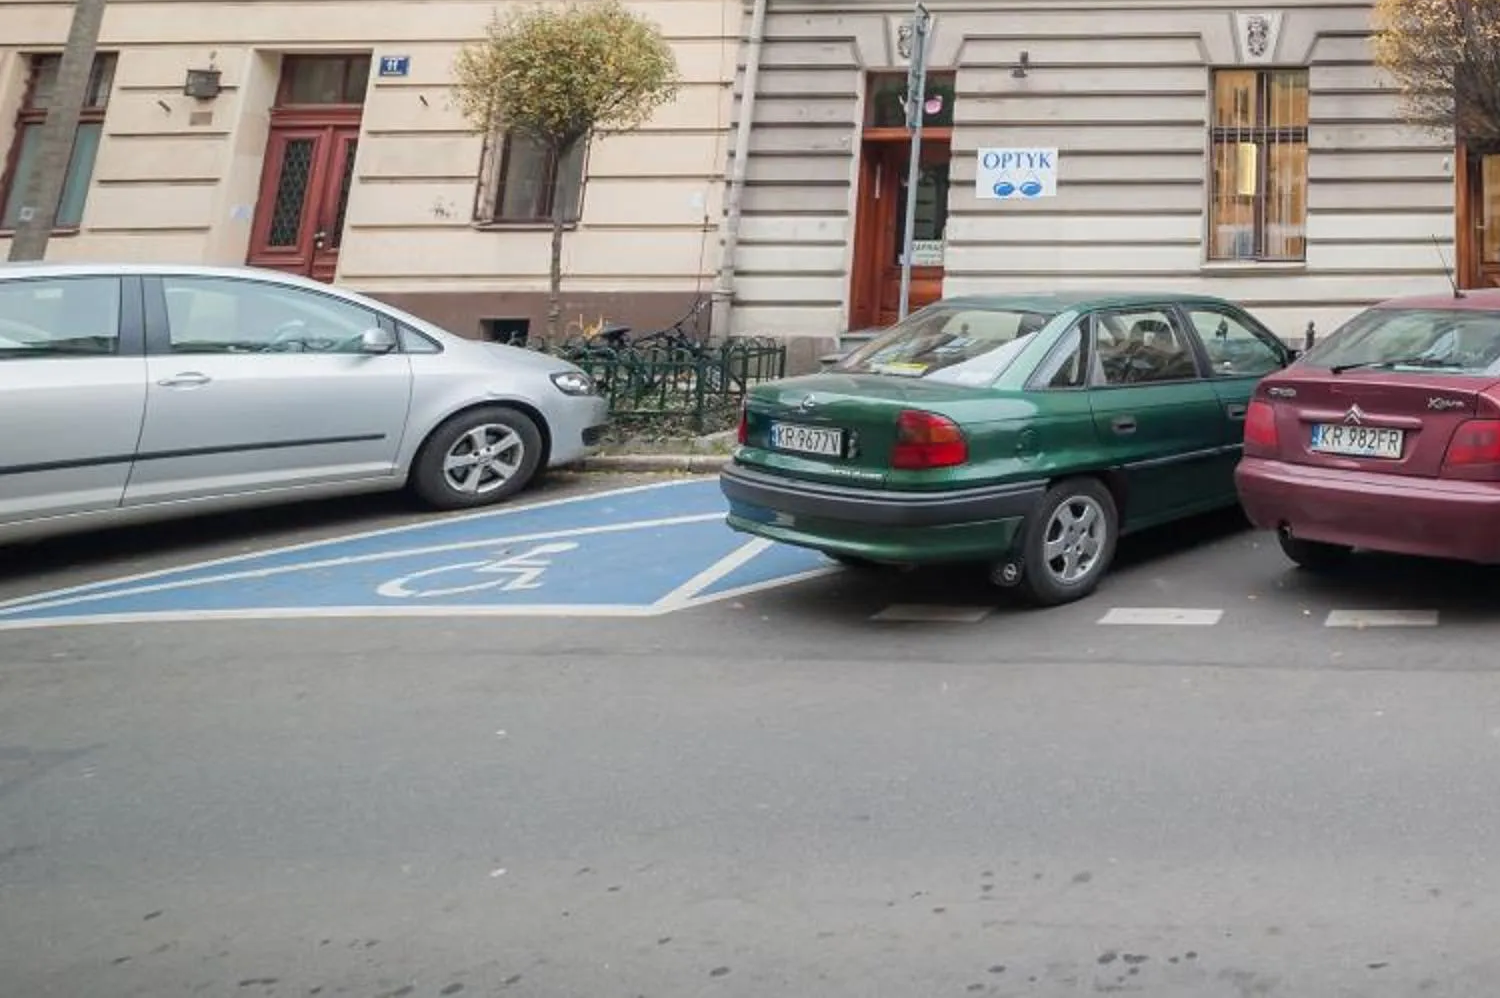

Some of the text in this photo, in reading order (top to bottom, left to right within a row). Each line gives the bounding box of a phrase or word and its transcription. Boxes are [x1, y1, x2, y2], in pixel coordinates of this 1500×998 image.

[983, 152, 1052, 169] OPTYK
[777, 426, 794, 447] KR
[1321, 425, 1399, 451] KR 982FR
